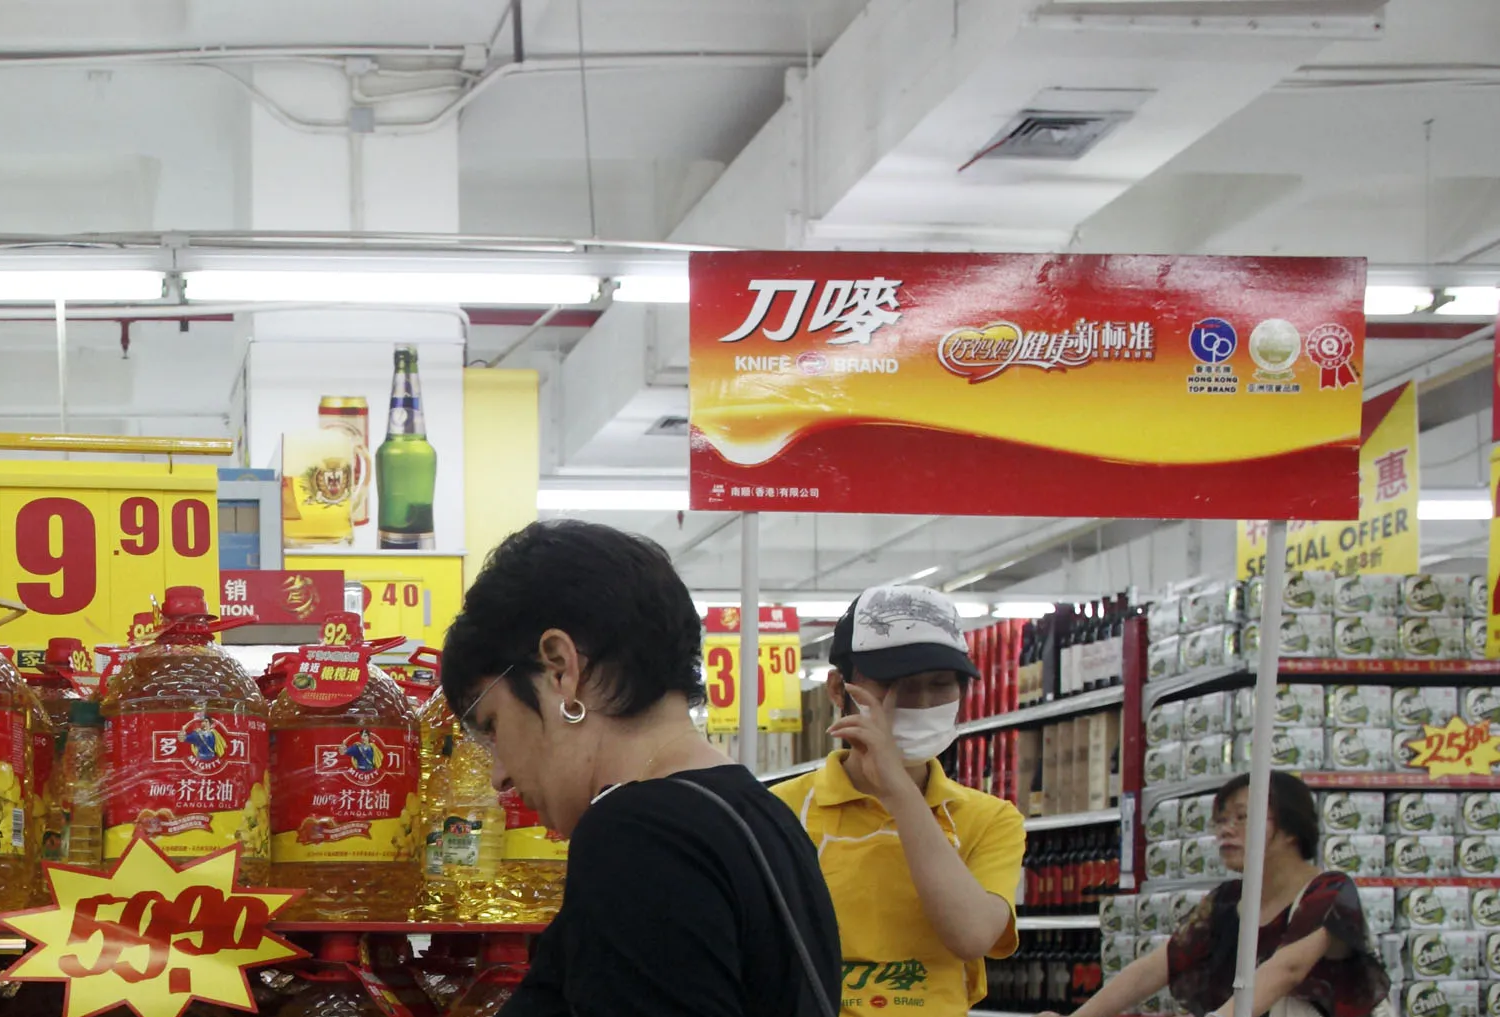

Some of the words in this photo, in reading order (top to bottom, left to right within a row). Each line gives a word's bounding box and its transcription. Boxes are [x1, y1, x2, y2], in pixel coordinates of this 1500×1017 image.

[734, 355, 792, 372] KNIFE
[833, 357, 900, 374] BRAND
[1188, 376, 1213, 384] HONG
[1214, 376, 1239, 384] KONG
[1188, 386, 1205, 394] TOP
[1207, 386, 1237, 394] BRAND
[1245, 535, 1331, 577] SPCIAL
[1338, 507, 1409, 551] OFFER
[224, 579, 248, 602] 销
[159, 737, 177, 755] 多
[186, 754, 222, 774] MIGHTY
[321, 750, 339, 768] 多
[347, 768, 380, 784] MIGHTY
[149, 783, 175, 797] 100%
[176, 778, 234, 801] 芥花油
[312, 793, 337, 806] 100%
[338, 788, 391, 811] 芥花油
[893, 997, 925, 1008] BRAND
[1412, 990, 1447, 1014] chill
